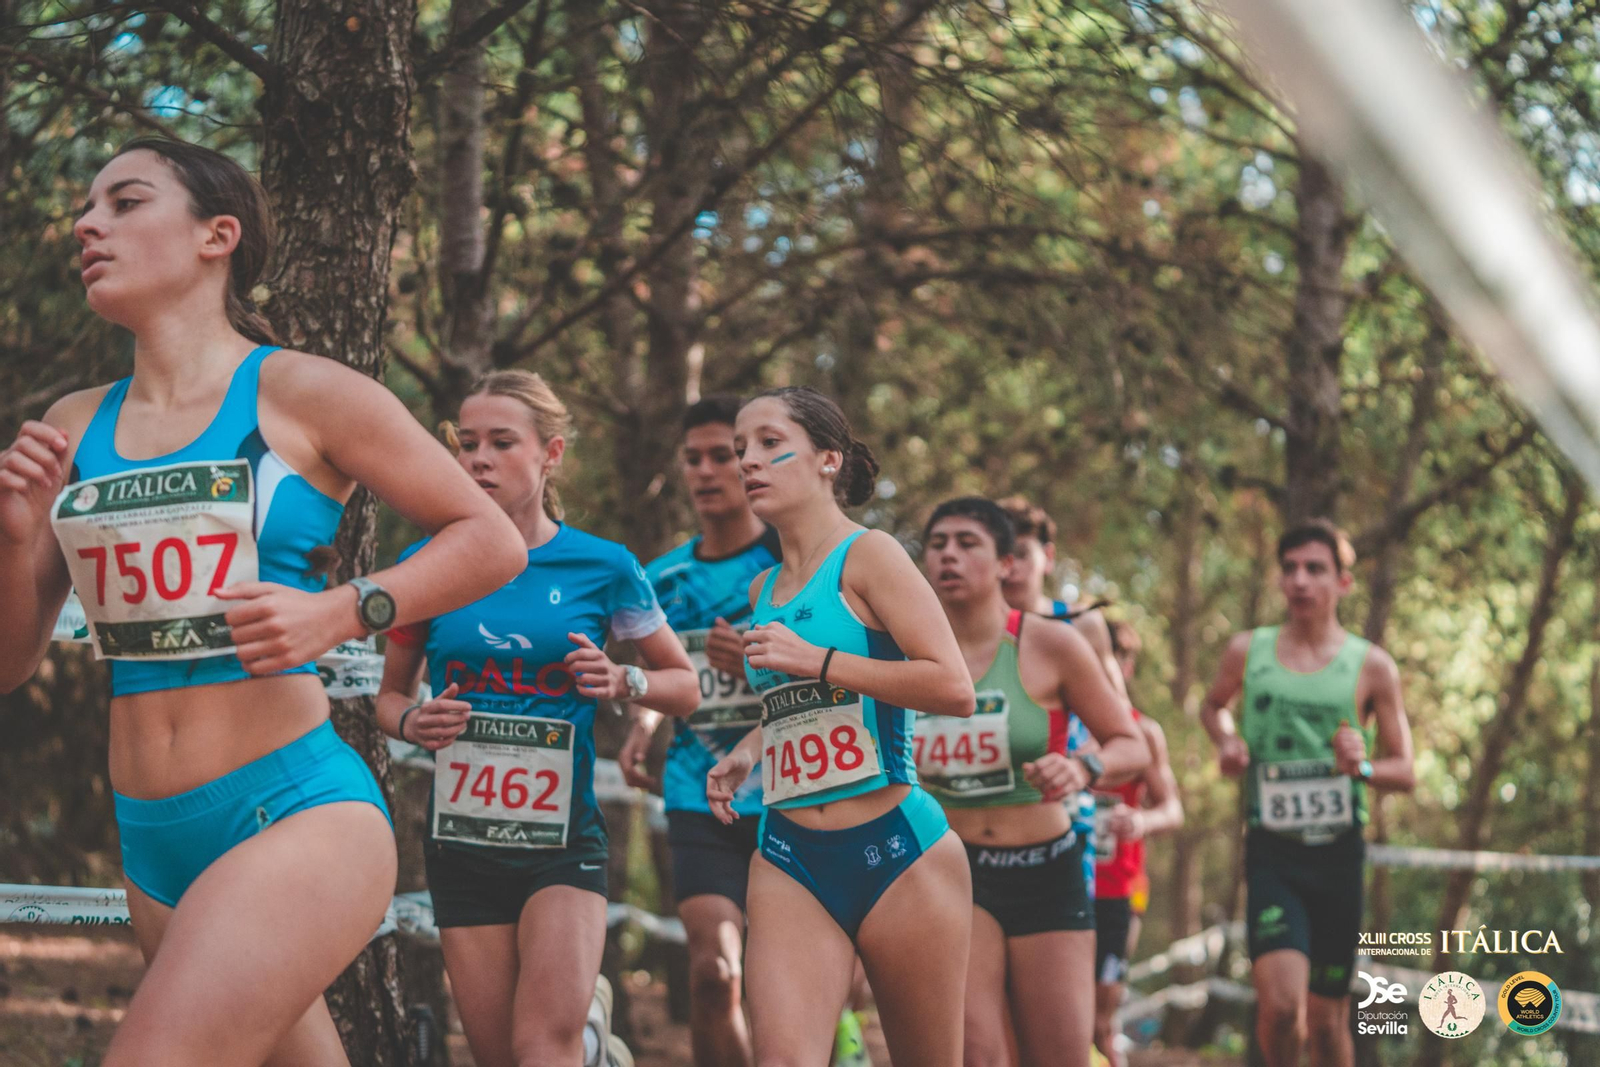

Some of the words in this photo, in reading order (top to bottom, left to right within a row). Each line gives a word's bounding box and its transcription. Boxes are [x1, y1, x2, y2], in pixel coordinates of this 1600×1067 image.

[106, 471, 198, 501] ITÁLICA
[77, 532, 238, 607] 7507
[474, 716, 538, 739] ITÁLICA
[912, 730, 1000, 768] 7445
[449, 762, 560, 812] 7462
[1270, 788, 1344, 820] 8153
[978, 846, 1047, 867] NIKE
